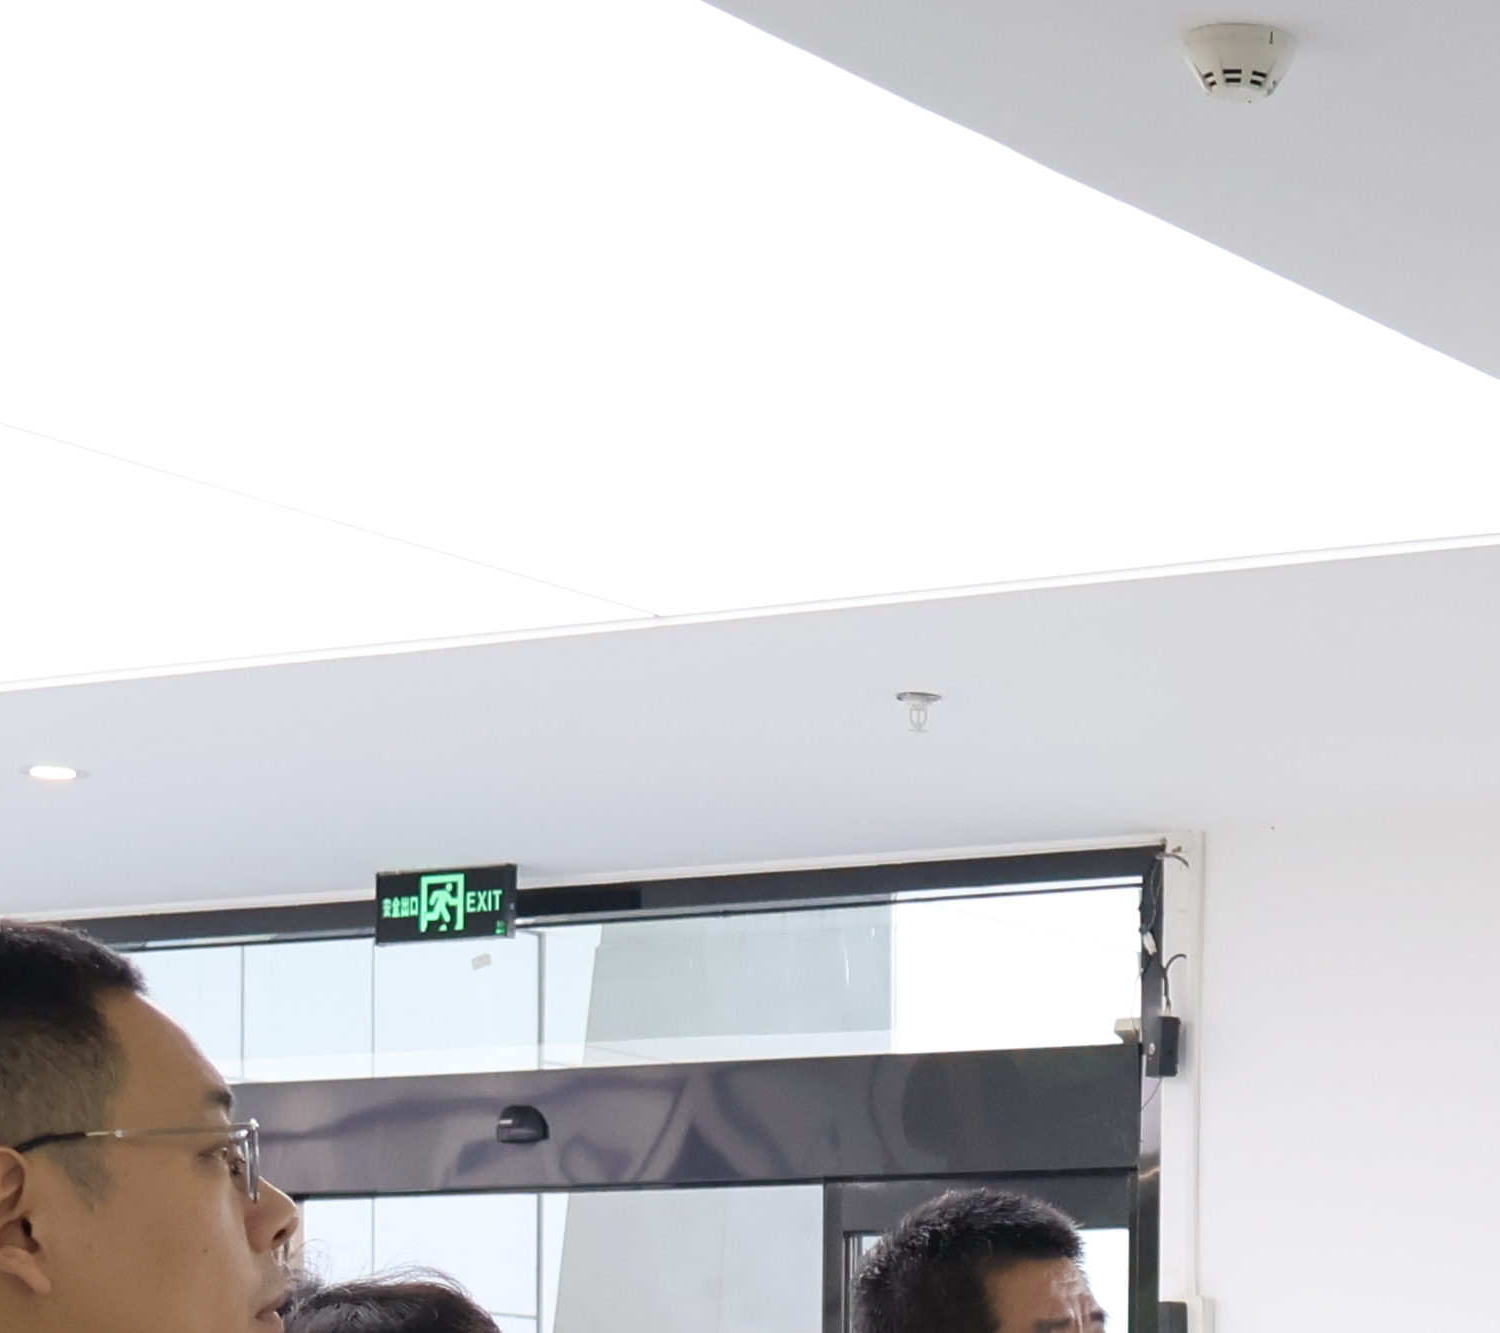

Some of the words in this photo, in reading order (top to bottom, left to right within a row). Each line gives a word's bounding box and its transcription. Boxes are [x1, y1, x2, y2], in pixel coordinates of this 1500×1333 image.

[381, 896, 419, 918] 安全出口
[466, 889, 503, 913] EXIT
